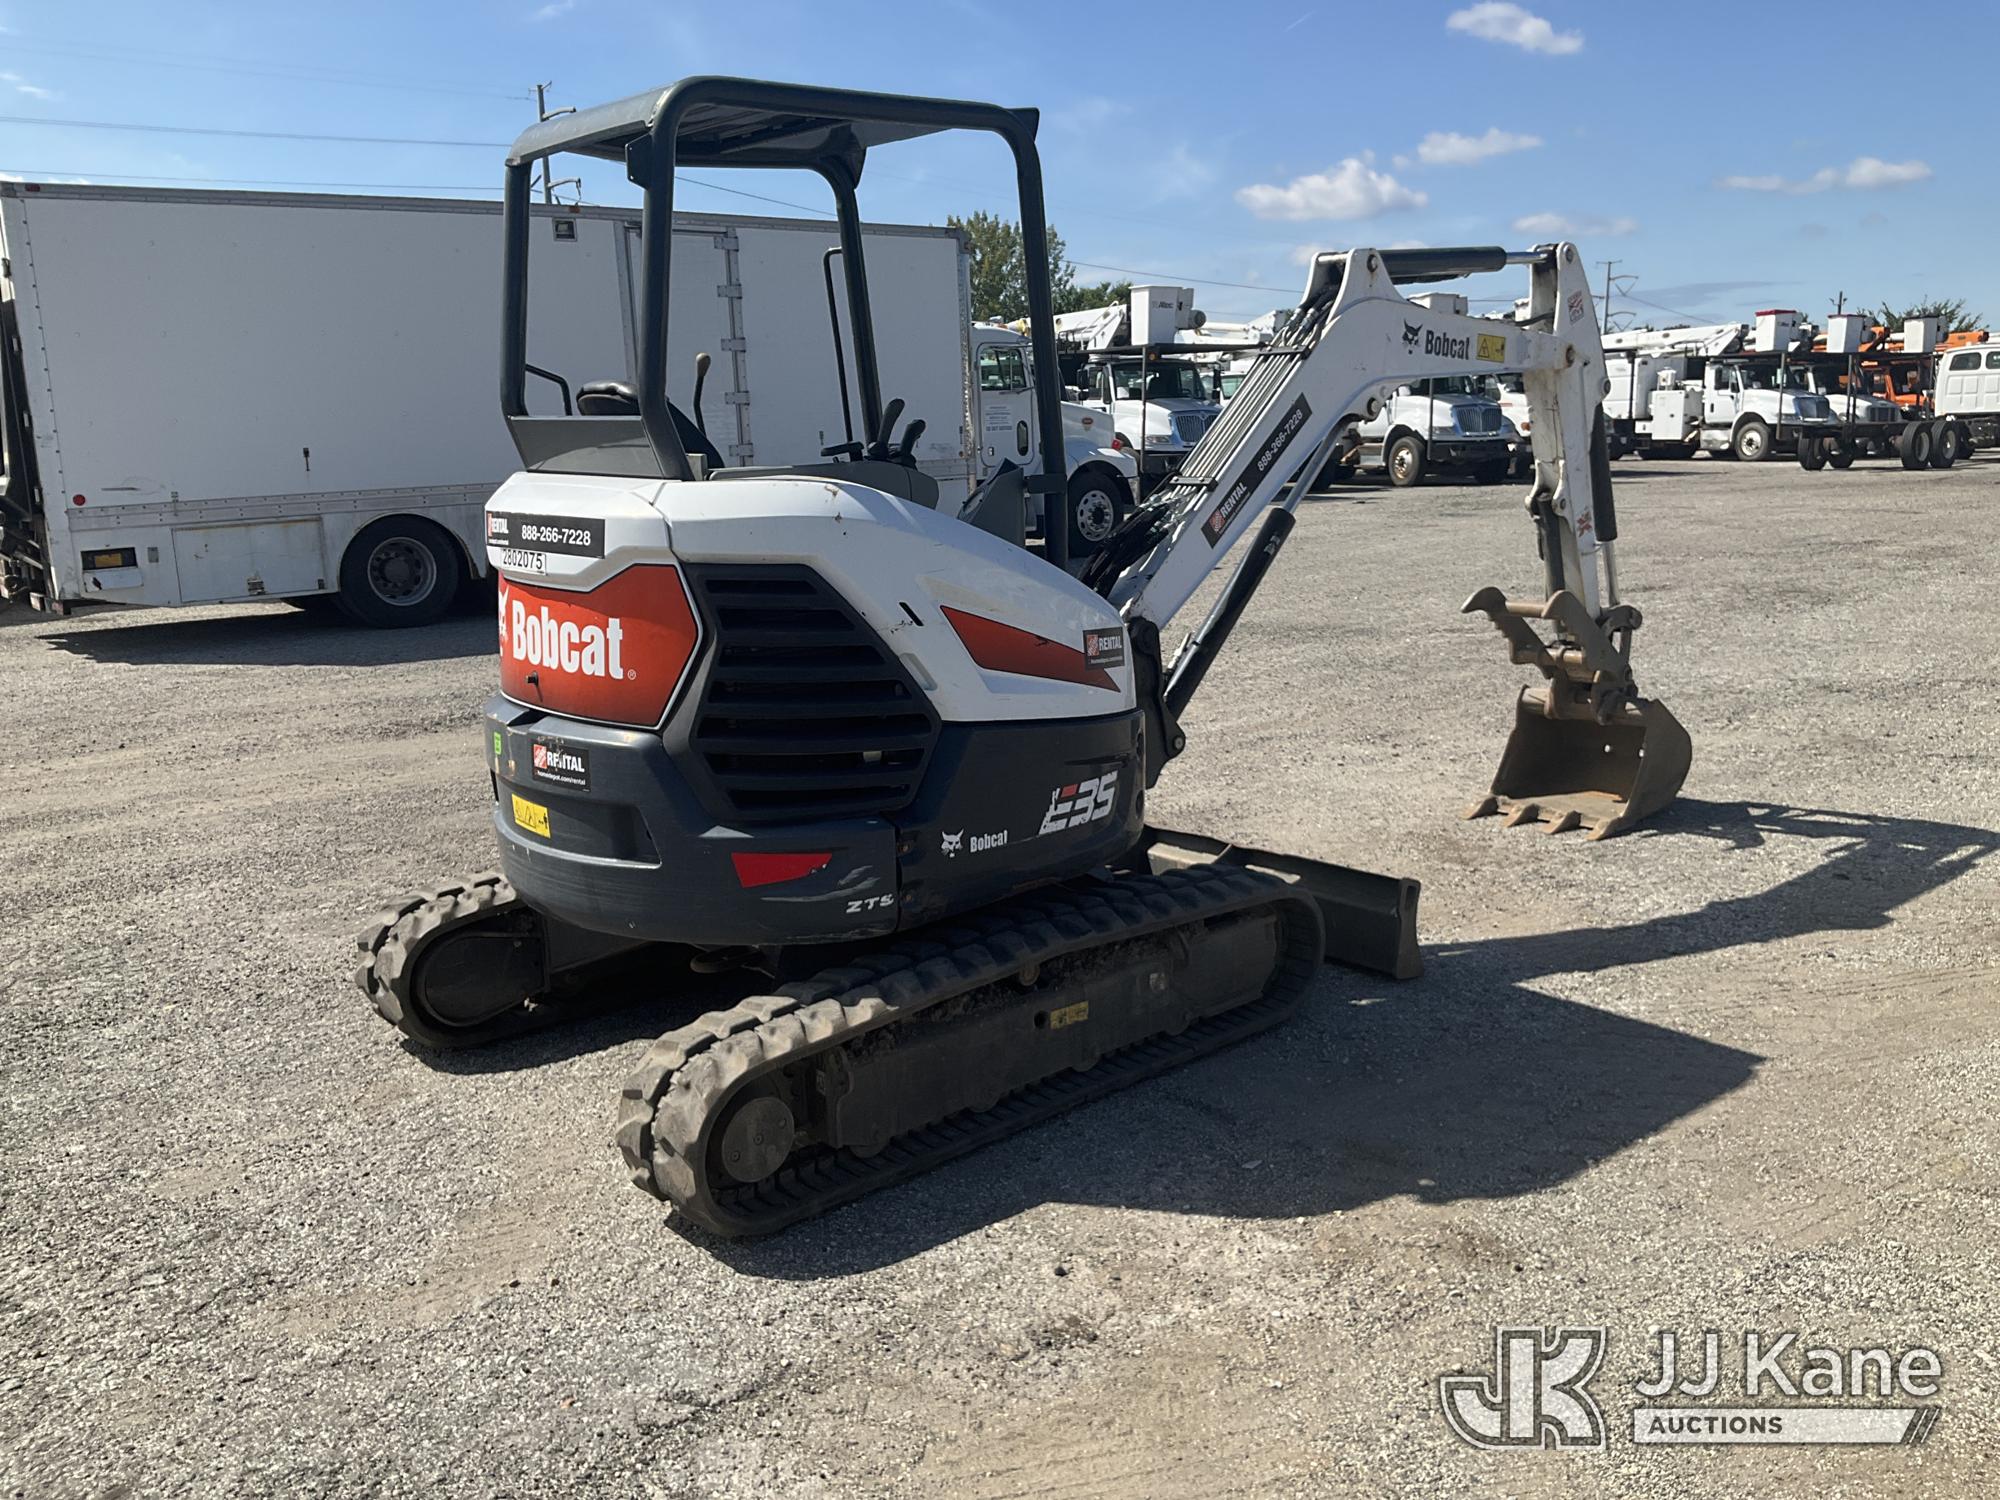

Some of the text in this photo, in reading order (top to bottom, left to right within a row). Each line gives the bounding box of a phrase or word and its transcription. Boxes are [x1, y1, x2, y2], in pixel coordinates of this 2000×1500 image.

[1425, 329, 1470, 361] Bobcat
[1220, 481, 1248, 519] RENTAL
[1257, 409, 1303, 472] 888-266-7228
[521, 525, 591, 546] 888-266-7228
[503, 548, 543, 570] 2802075
[512, 599, 624, 680] Bobcat
[1099, 637, 1122, 651] RENTAL
[969, 829, 1008, 854] Bobcat
[846, 894, 895, 914] ZTS
